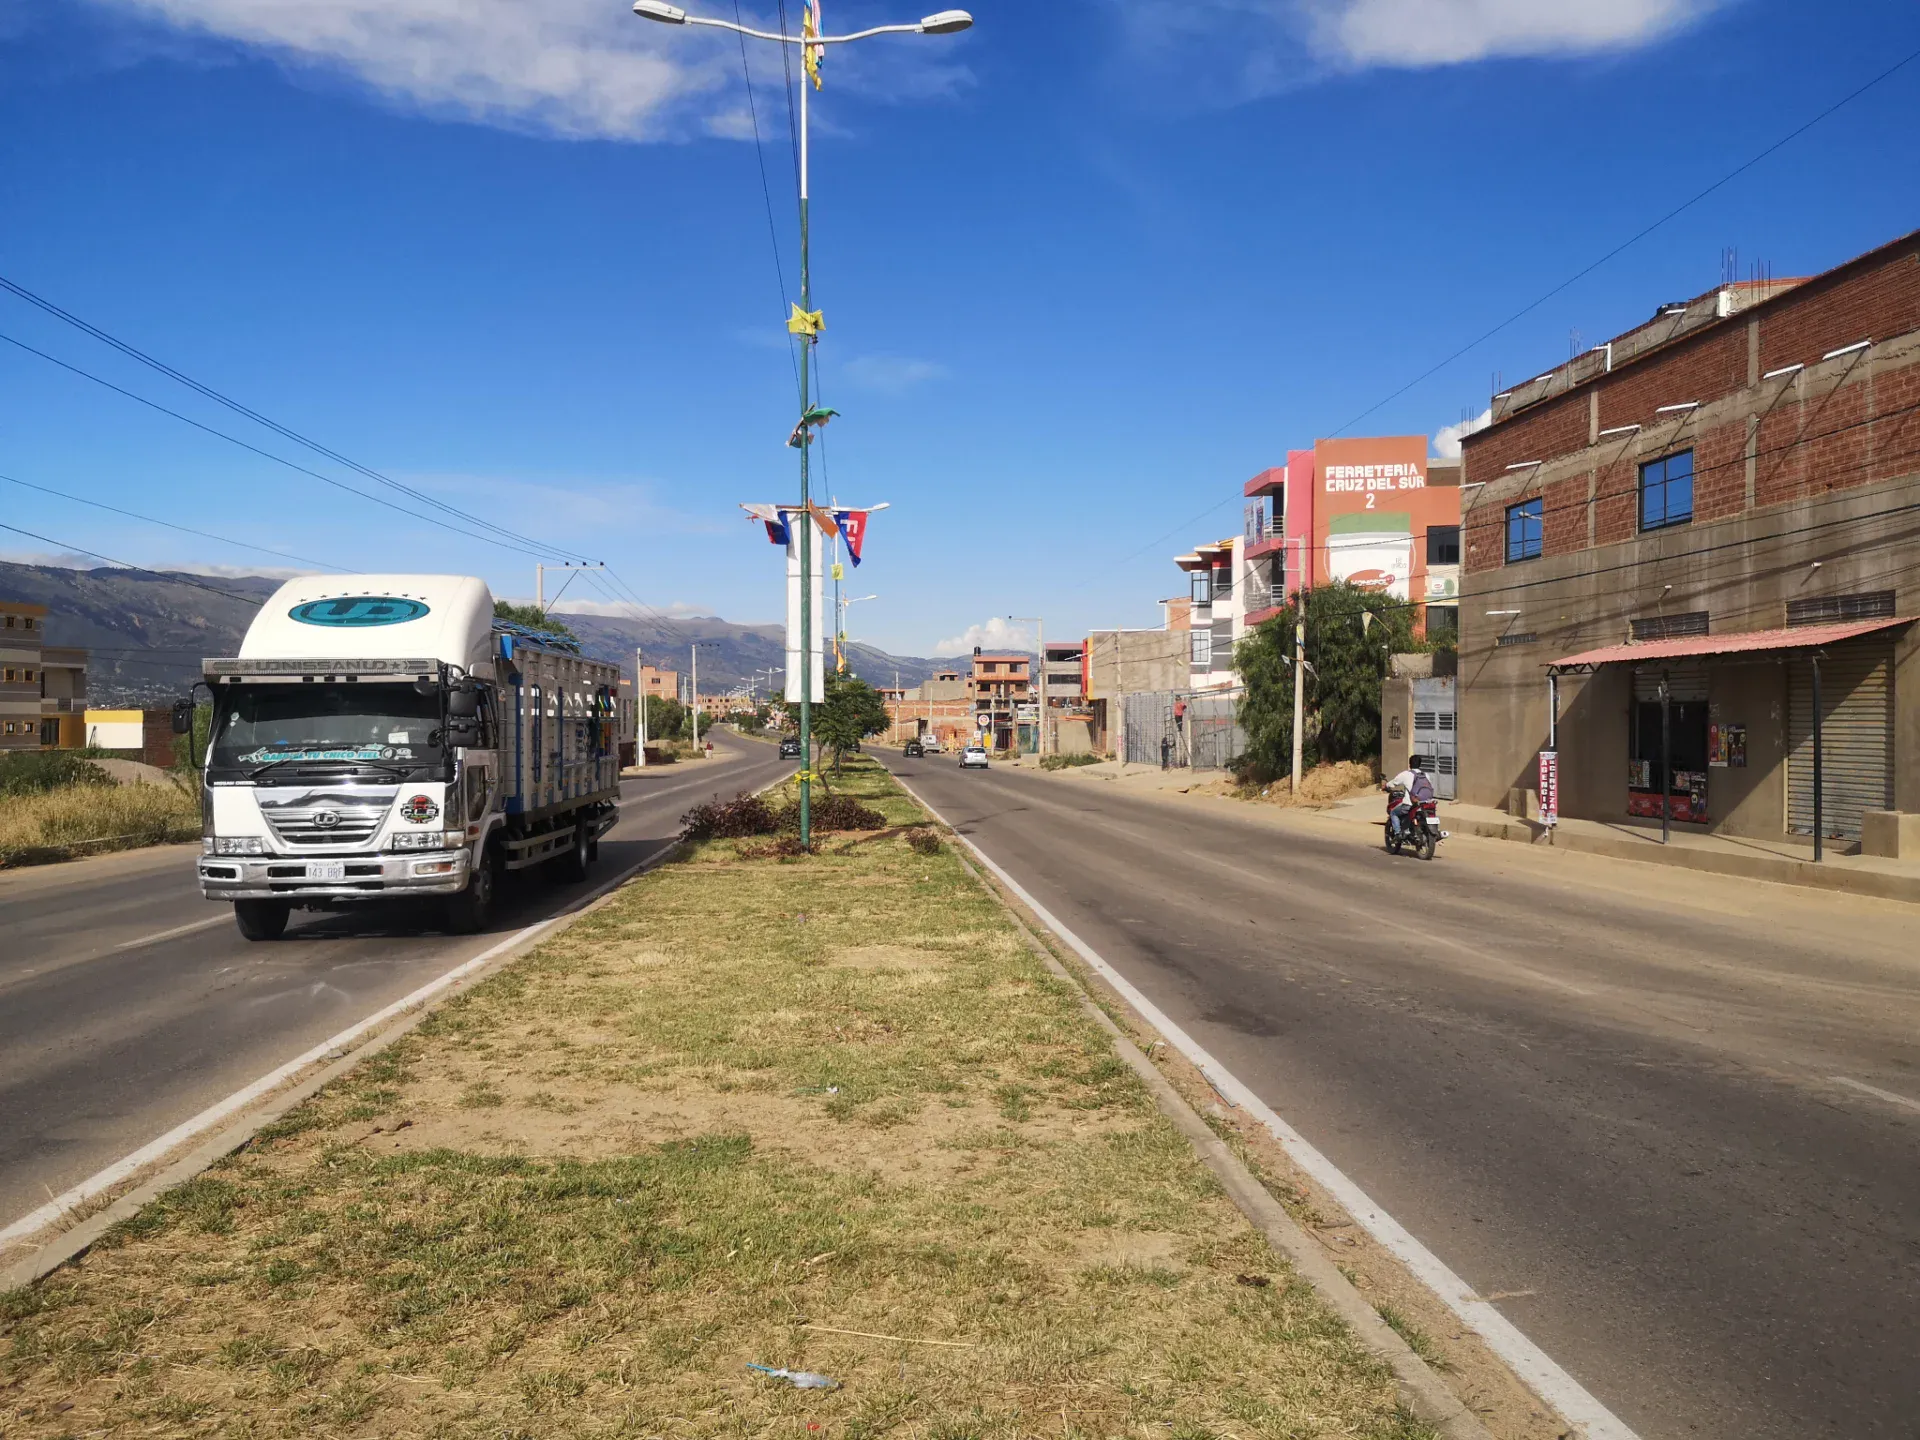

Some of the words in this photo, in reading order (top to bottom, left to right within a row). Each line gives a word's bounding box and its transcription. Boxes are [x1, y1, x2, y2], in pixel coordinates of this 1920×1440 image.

[1325, 463, 1418, 479] FERRETERIA
[1325, 479, 1364, 492] CRUZ
[1366, 478, 1396, 490] DEL
[1398, 476, 1424, 489] SUR
[1365, 493, 1375, 508] 2
[306, 751, 321, 760] TU
[322, 750, 355, 760] CHICO
[357, 750, 380, 760] FIEL
[308, 867, 323, 878] 143
